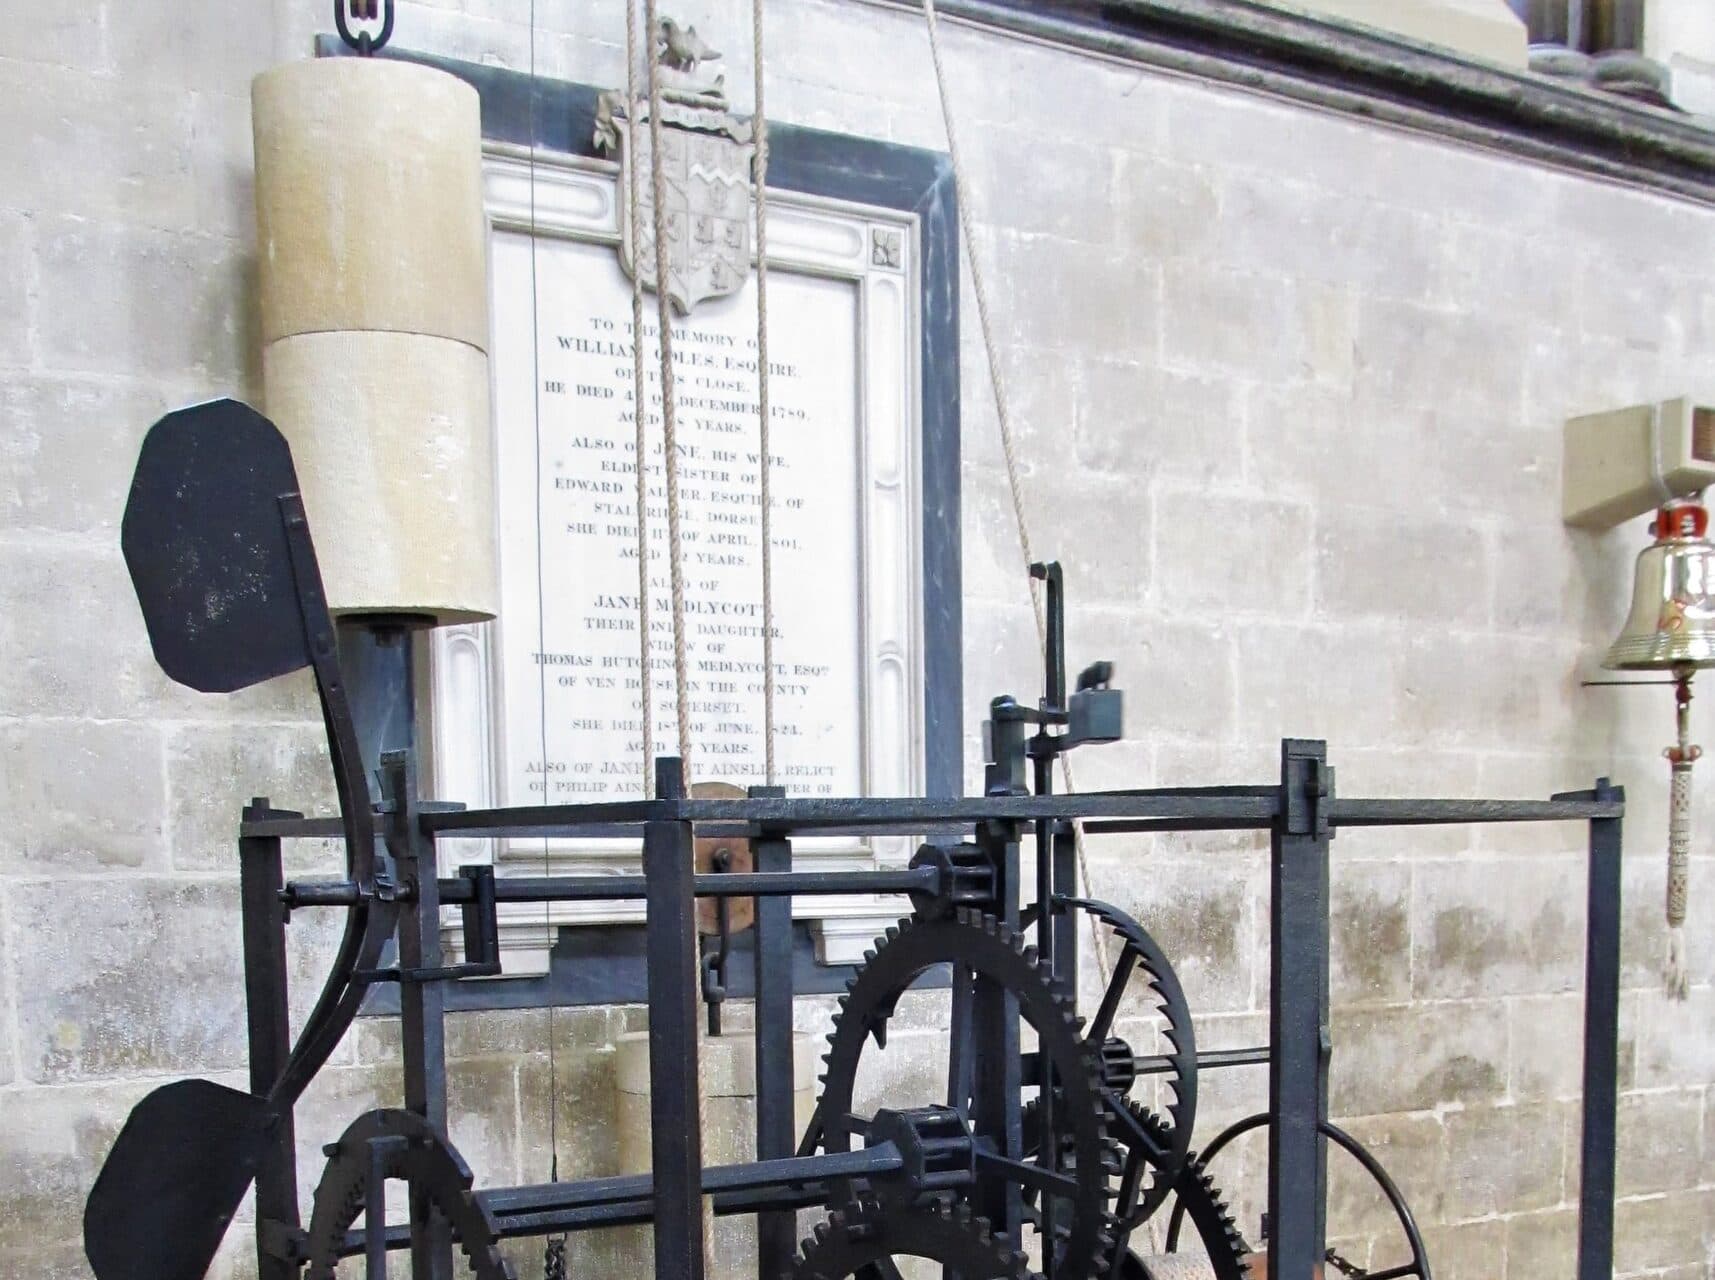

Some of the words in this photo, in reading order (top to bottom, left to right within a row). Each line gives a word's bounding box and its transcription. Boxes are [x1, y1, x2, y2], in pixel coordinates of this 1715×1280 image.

[590, 318, 614, 331] TO
[669, 328, 736, 347] MEMORY
[647, 370, 684, 384] TIS
[545, 381, 565, 394] HE
[577, 384, 614, 398] DIED
[679, 396, 760, 415] DECEMBER
[619, 411, 659, 425] AGD
[571, 437, 614, 450] ALSO
[712, 449, 736, 462] HIS
[674, 467, 729, 482] SISTER
[741, 473, 759, 484] OF
[554, 477, 623, 494] EDWARD
[786, 497, 804, 508] OF
[567, 523, 597, 535] SHE
[682, 531, 700, 542] OF
[619, 548, 661, 560] AGD
[649, 577, 691, 590] ALO
[700, 580, 720, 591] OF
[594, 595, 641, 609] JANE
[584, 617, 635, 630] THEIR
[650, 621, 684, 633] ONL
[648, 640, 696, 653] IDW
[707, 642, 726, 653] OF
[531, 653, 592, 667] THOMAS
[698, 660, 788, 676] MEDLYCOT,
[558, 676, 577, 688] OF
[586, 676, 616, 688] VEN
[625, 678, 674, 691] HOSE
[686, 681, 700, 692] IN
[706, 682, 737, 694] THE
[747, 684, 809, 696] CONTY
[660, 703, 747, 714] SOERSET.
[572, 720, 604, 731] SHE
[690, 722, 706, 733] OF
[626, 741, 666, 753] AGD
[525, 761, 567, 773] ALSO
[574, 762, 592, 774] OF
[601, 762, 645, 775] JANE
[711, 762, 781, 776] AINSLI,
[785, 766, 836, 777] RELICT
[530, 782, 547, 793] OF
[556, 782, 608, 793] PHILIP
[818, 784, 833, 794] OF
